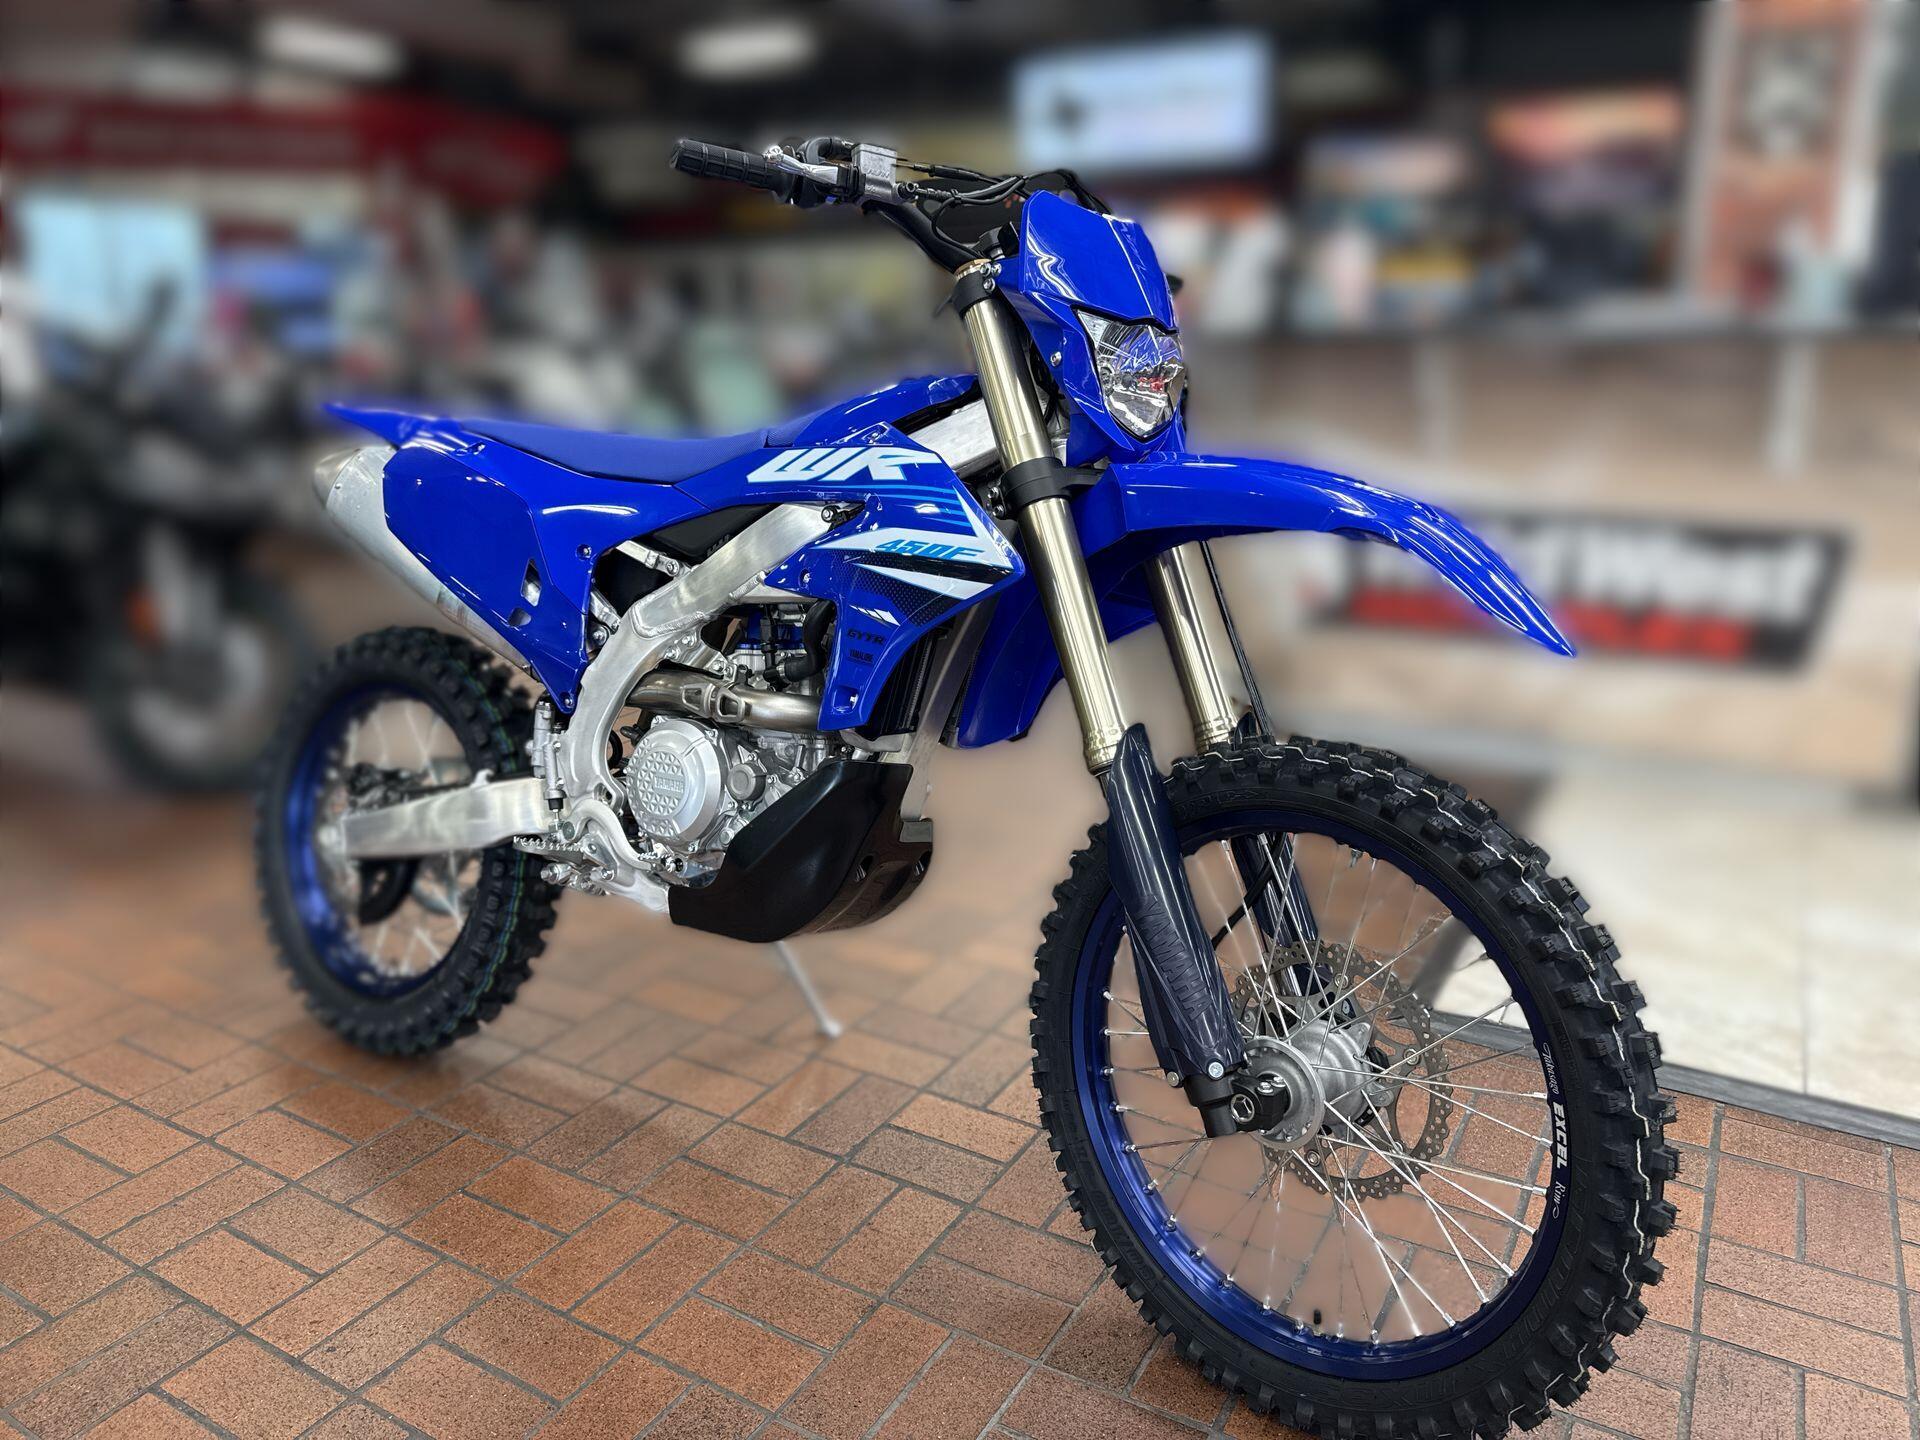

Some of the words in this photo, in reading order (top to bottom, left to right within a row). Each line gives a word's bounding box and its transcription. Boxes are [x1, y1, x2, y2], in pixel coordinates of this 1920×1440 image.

[746, 447, 941, 483] WR
[875, 538, 985, 560] 450F
[654, 775, 684, 793] YAMAHA
[1134, 894, 1215, 1021] YAMAHA
[1541, 1041, 1560, 1095] Takasago
[1552, 1103, 1567, 1169] EXCEL
[1552, 1180, 1567, 1218] Rim
